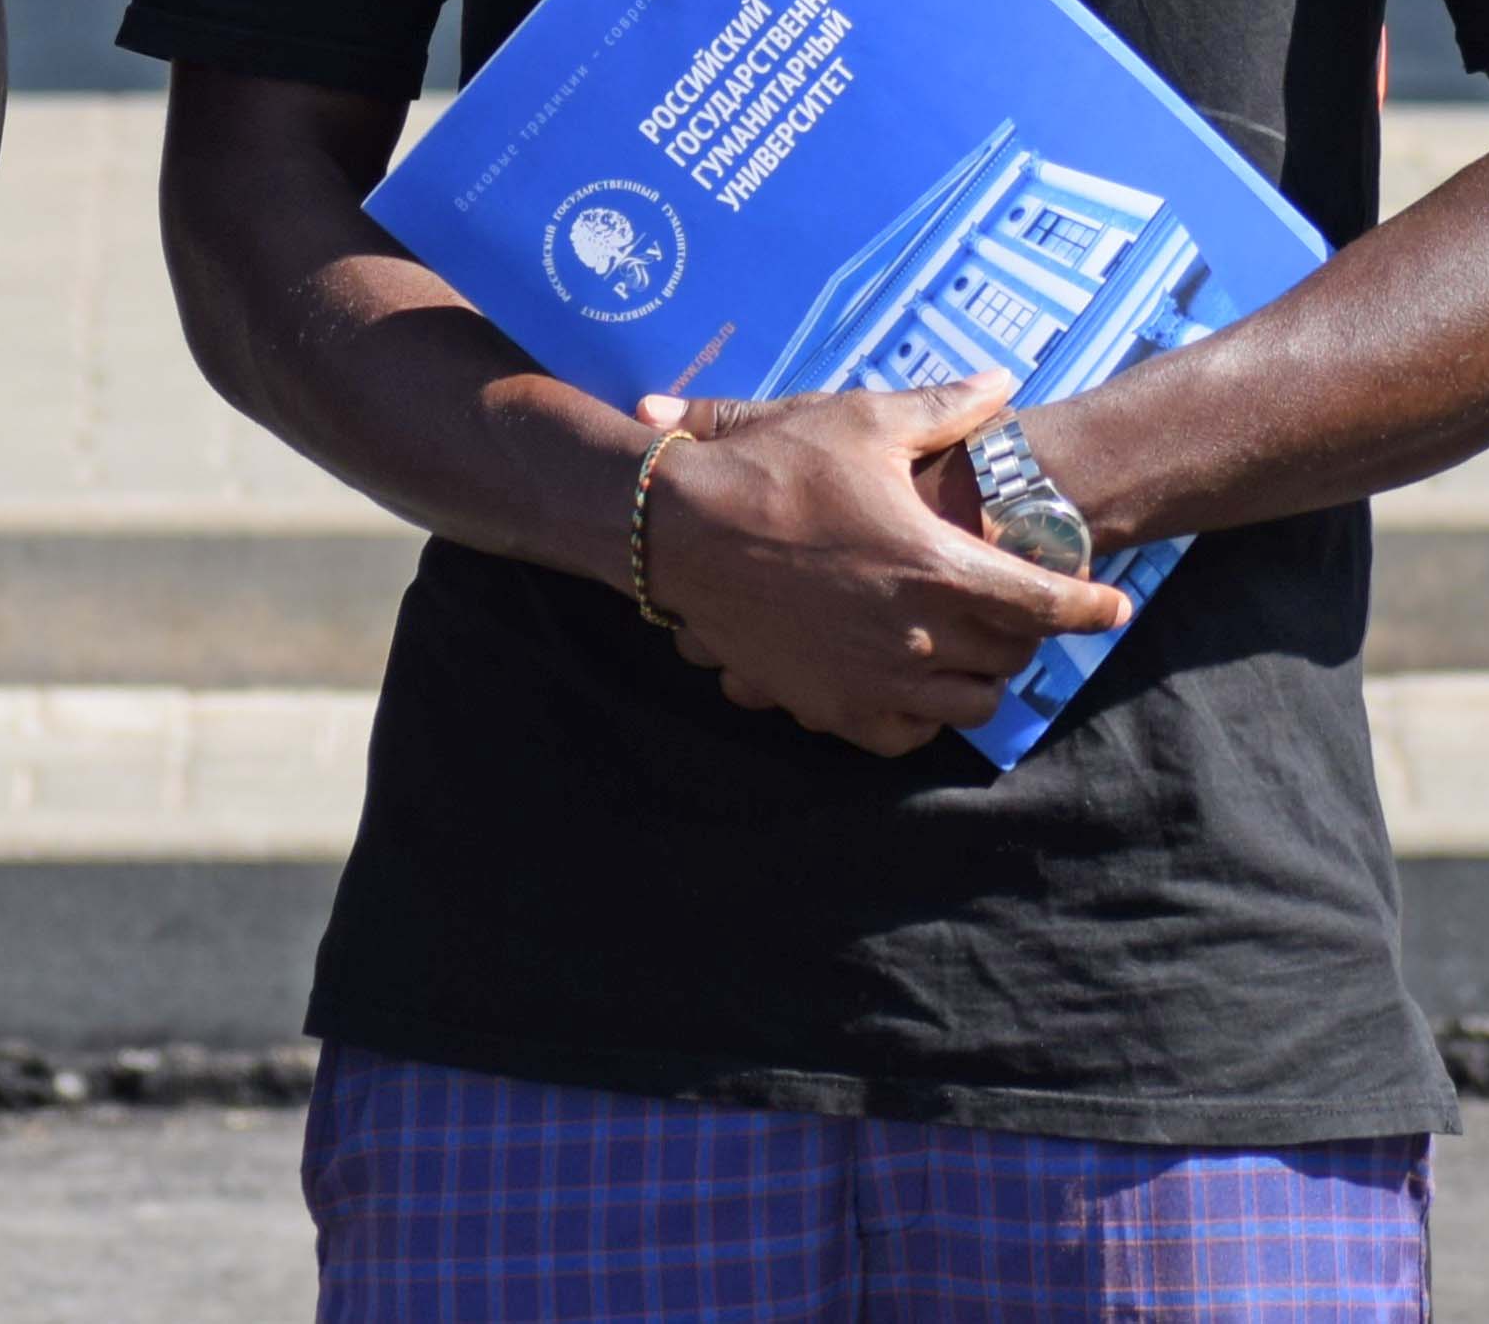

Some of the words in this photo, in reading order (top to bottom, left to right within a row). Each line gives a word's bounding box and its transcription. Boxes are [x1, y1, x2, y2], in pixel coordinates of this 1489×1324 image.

[453, 143, 519, 212] Вековые
[519, 64, 589, 140] традиции
[690, 7, 853, 191] ГУМАНИТАРНЫЙ
[716, 57, 855, 212] УНИВЕРСИТЕТ
